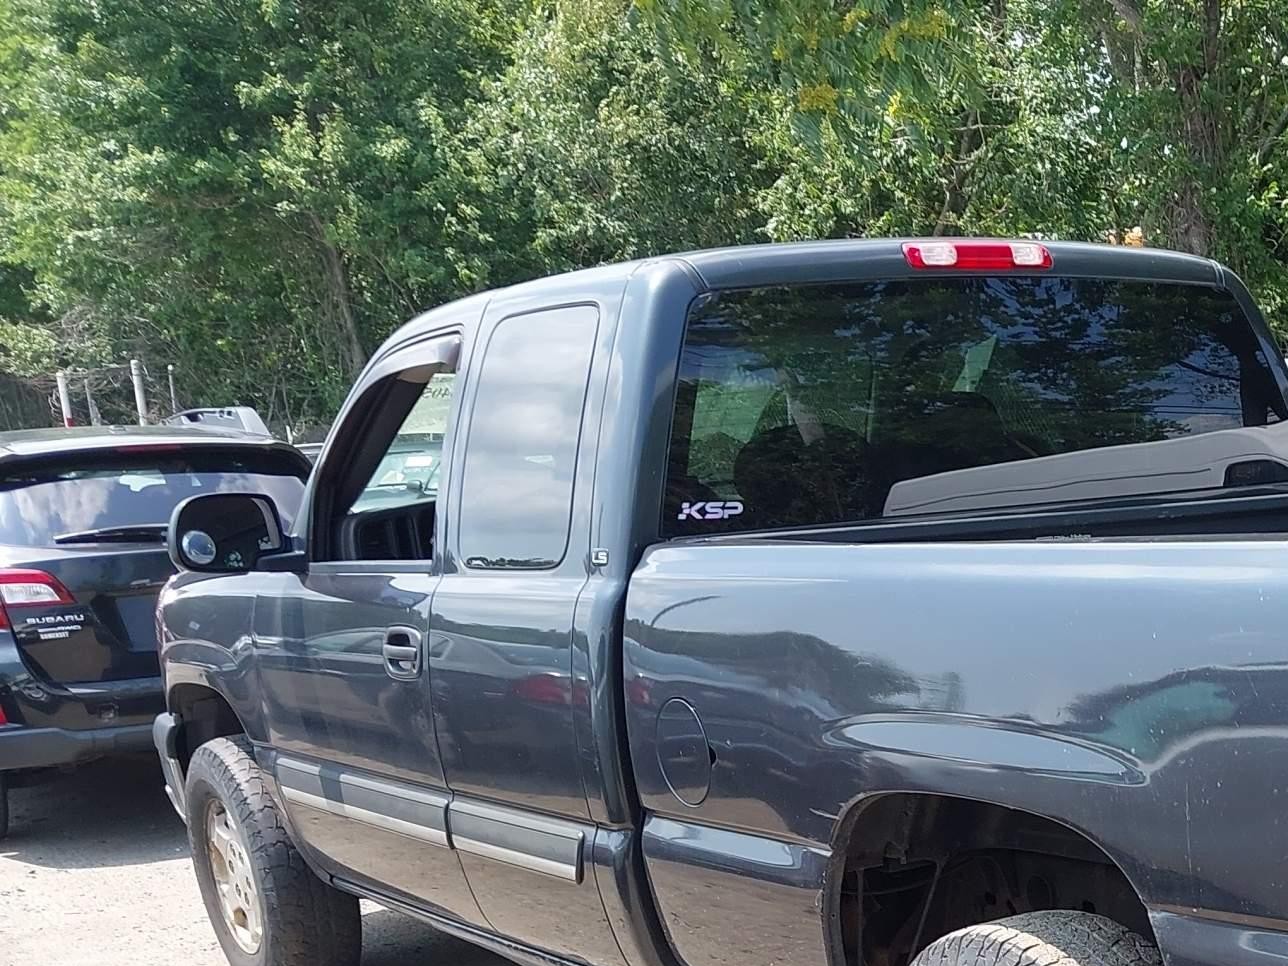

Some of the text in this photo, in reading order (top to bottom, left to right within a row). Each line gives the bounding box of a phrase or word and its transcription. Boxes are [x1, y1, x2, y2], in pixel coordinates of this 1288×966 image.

[677, 501, 744, 520] KSP
[591, 551, 608, 564] LS
[26, 614, 84, 624] SUBARU
